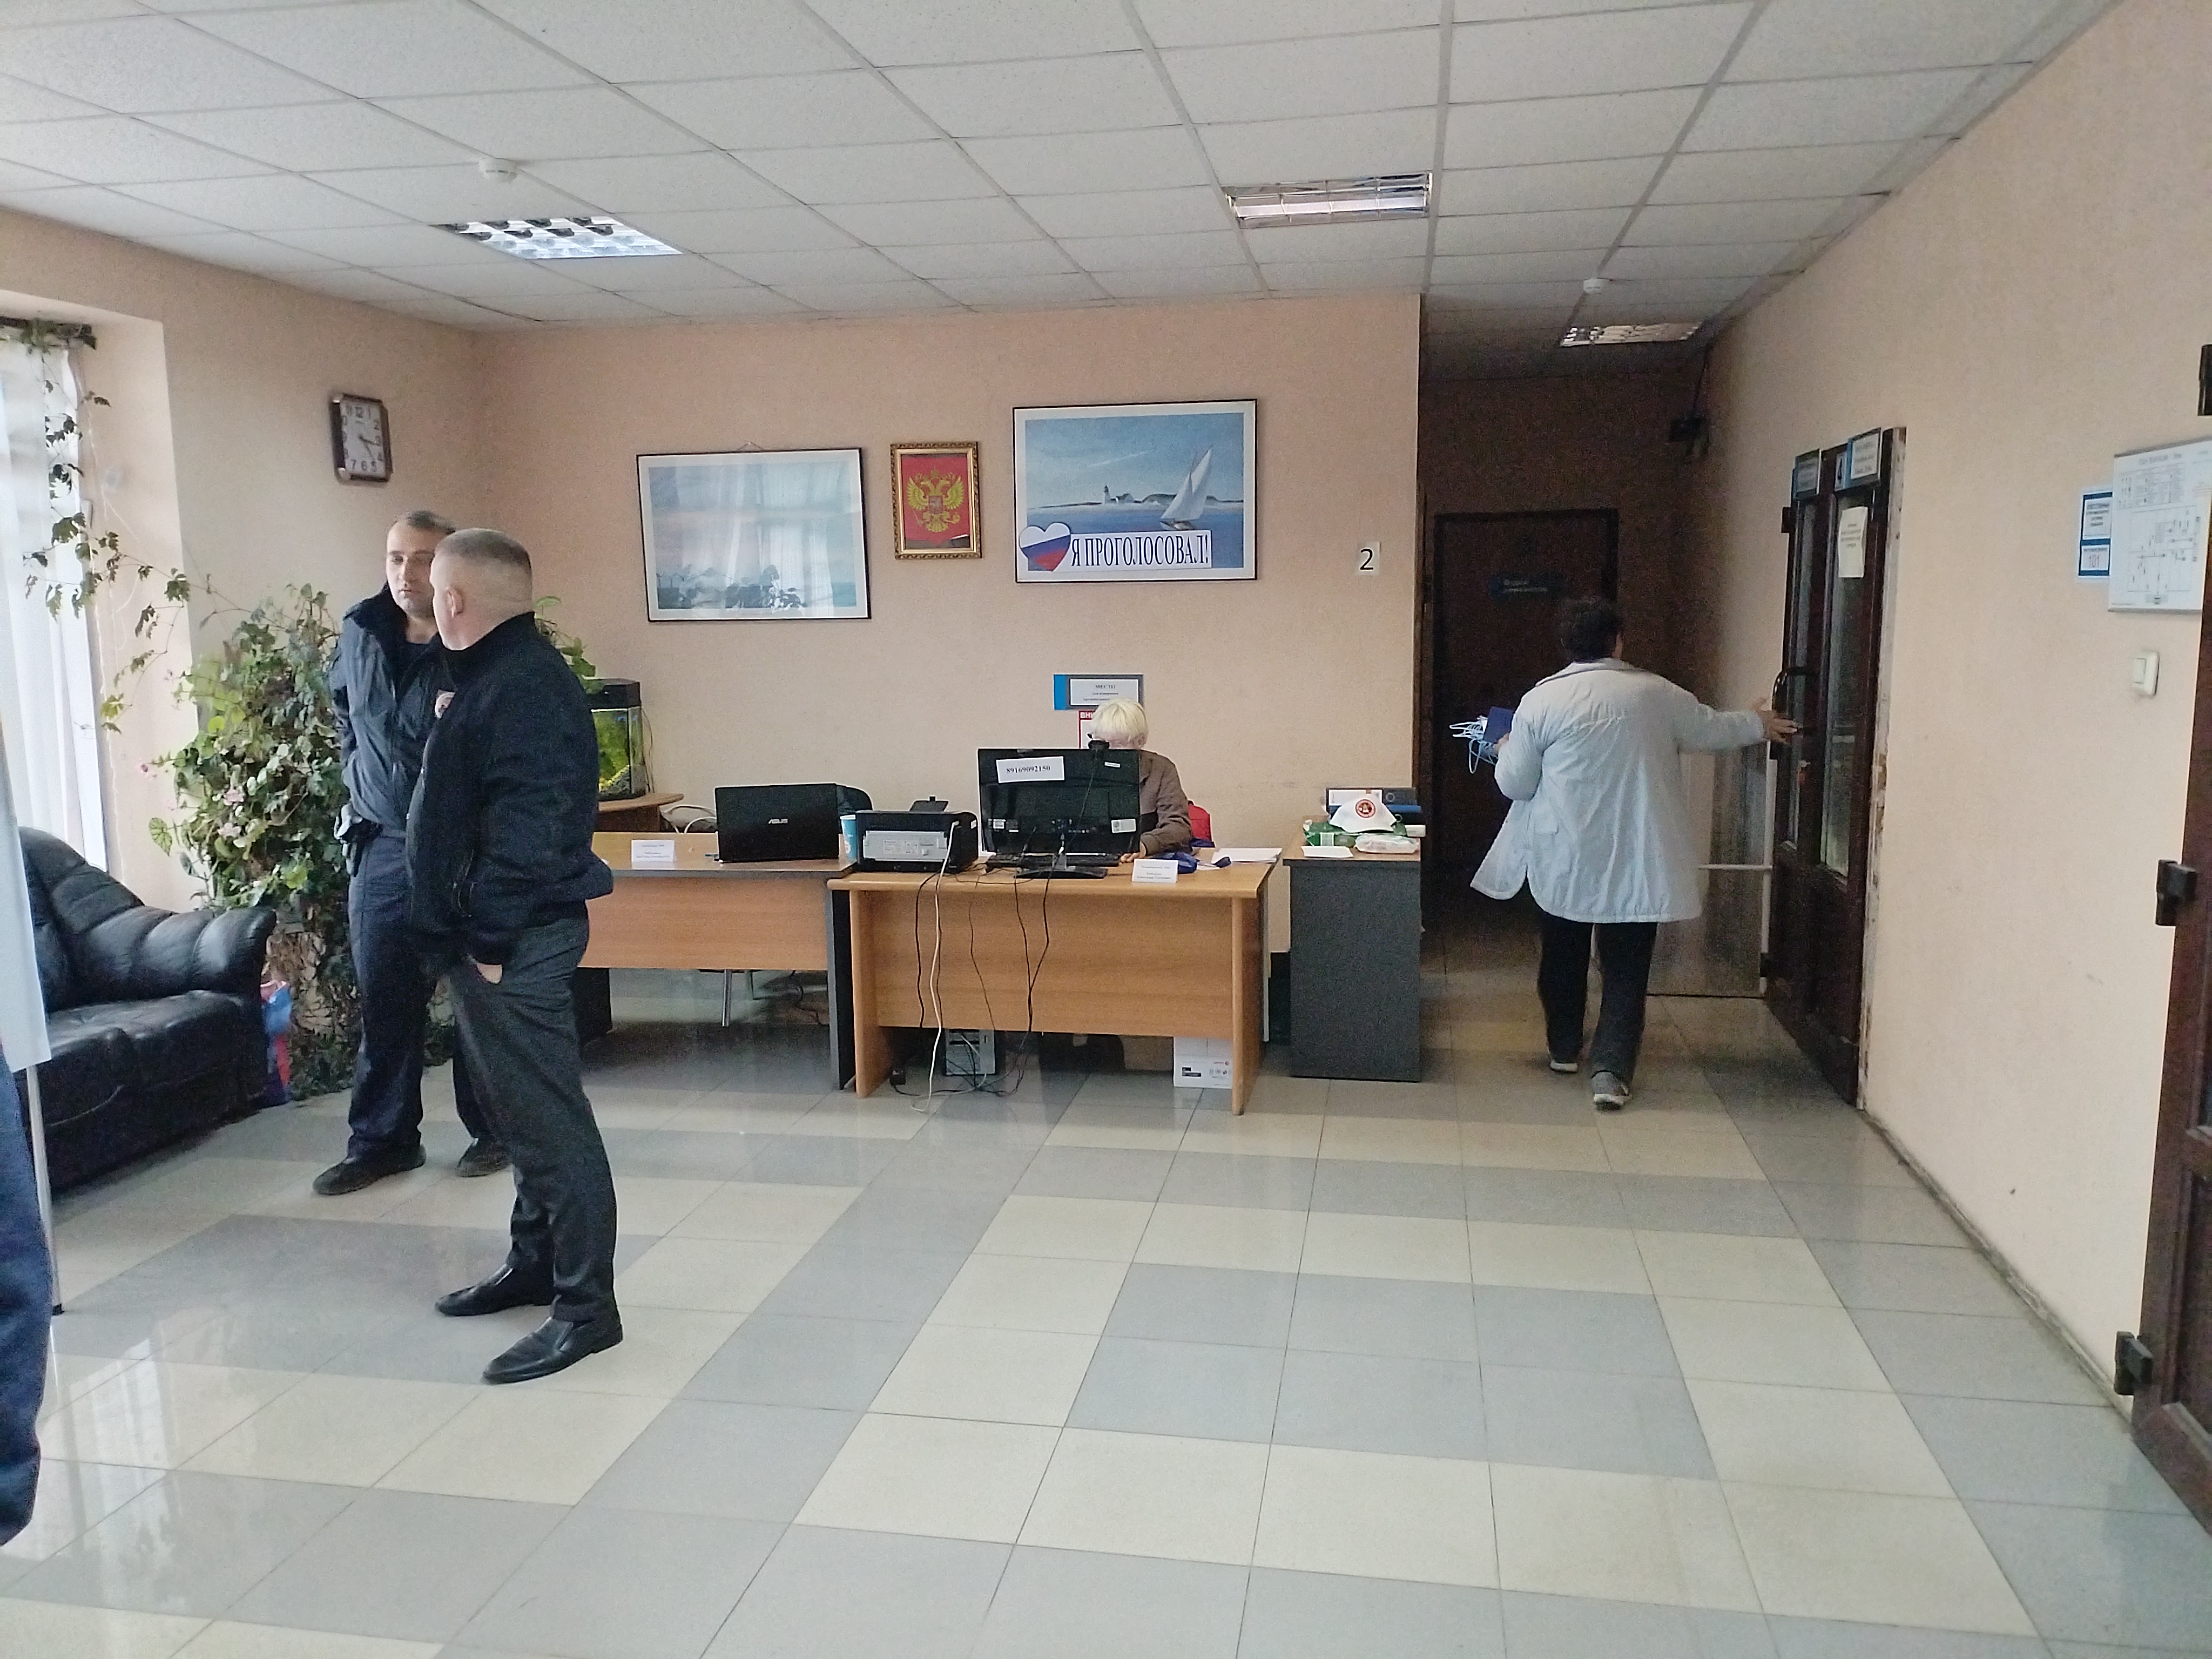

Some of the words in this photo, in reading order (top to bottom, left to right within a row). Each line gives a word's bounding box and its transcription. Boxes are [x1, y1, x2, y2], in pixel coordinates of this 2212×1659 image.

[374, 420, 379, 430] 2
[350, 459, 356, 470] 7
[361, 460, 367, 472] 6
[1071, 538, 1081, 567] Я
[1084, 534, 1209, 567] ПРОГОЛОСОВАЛ!
[1360, 548, 1374, 570] 2
